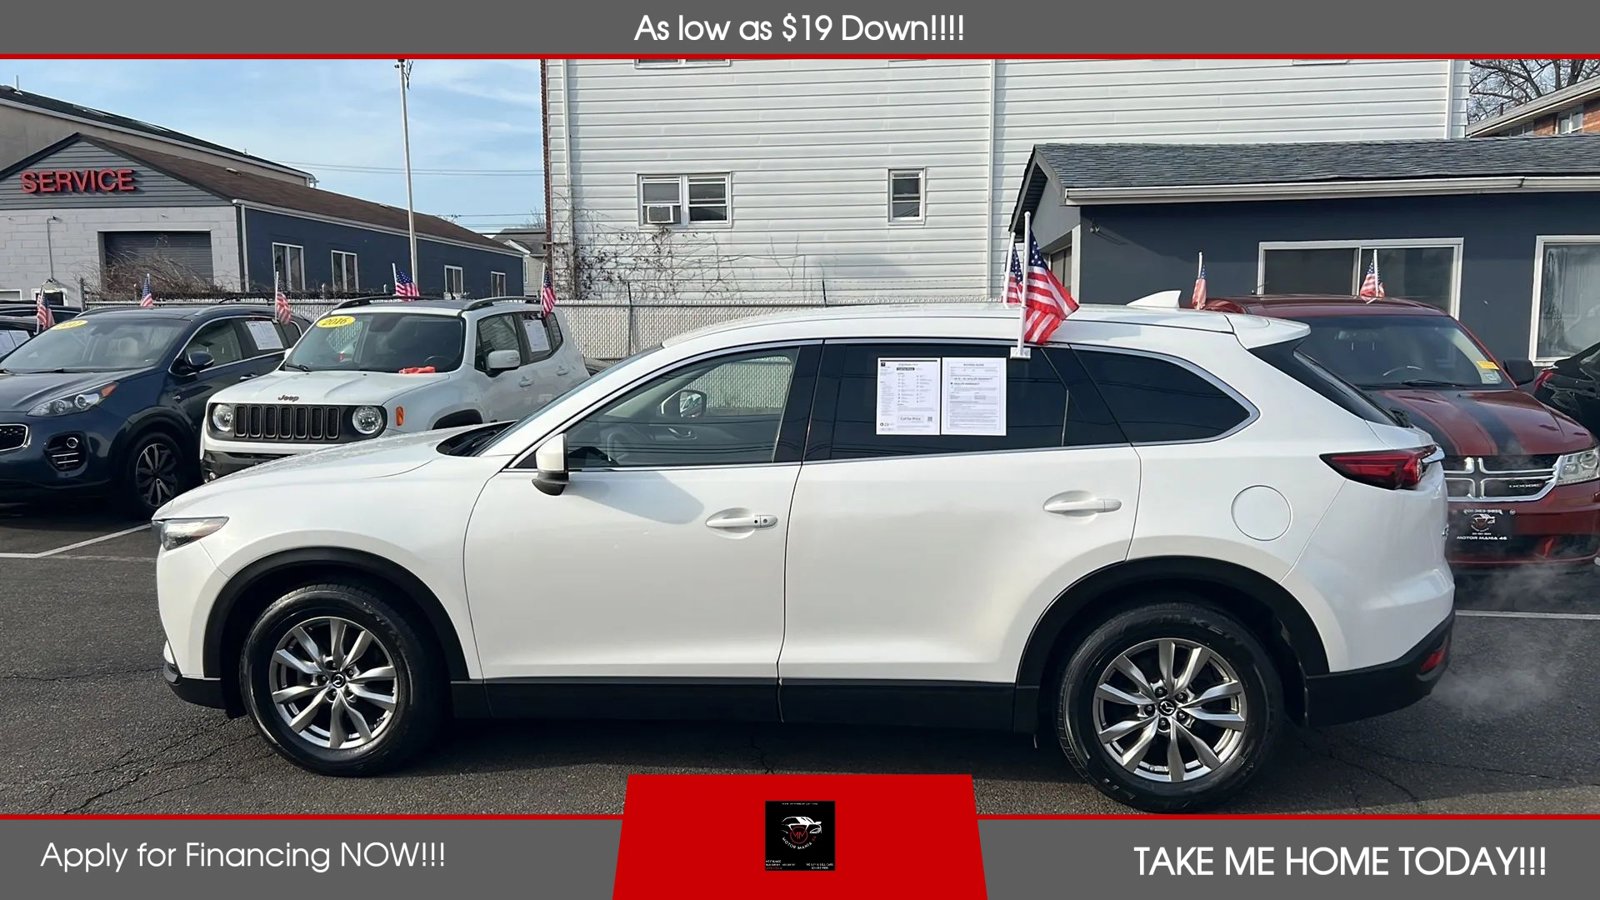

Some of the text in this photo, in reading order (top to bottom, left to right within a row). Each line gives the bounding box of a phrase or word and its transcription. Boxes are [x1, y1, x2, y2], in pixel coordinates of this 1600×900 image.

[20, 168, 135, 193] SERVICE
[321, 317, 348, 326] 2016
[277, 394, 300, 403] Jeep
